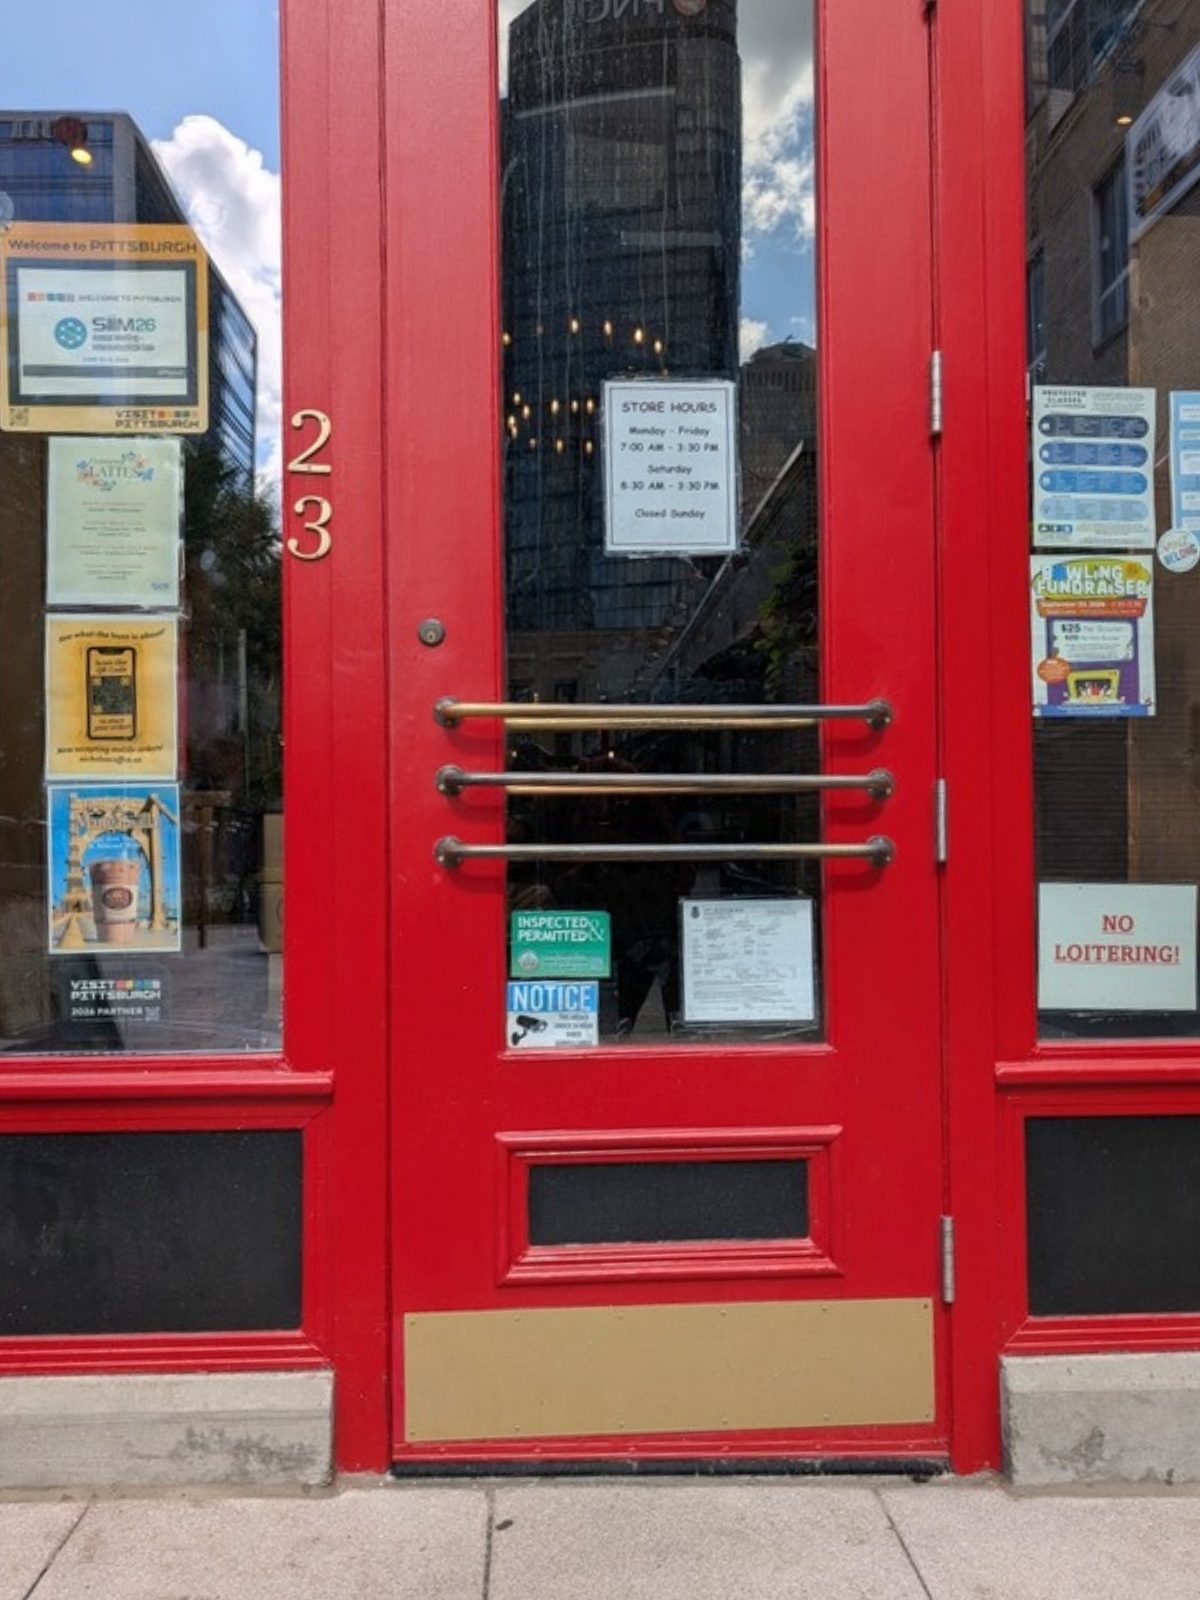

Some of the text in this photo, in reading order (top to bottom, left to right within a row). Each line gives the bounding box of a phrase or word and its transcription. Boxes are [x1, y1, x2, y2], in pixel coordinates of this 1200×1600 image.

[8, 240, 197, 254] Welcome to PITTSBURGH
[621, 402, 717, 413] STORE HOURS
[115, 410, 155, 419] VISIT
[114, 420, 199, 429] PITTSBURGH
[629, 427, 666, 436] Monday
[678, 426, 710, 437] Friday
[648, 443, 664, 452] AM
[704, 443, 719, 452] PM
[647, 465, 692, 475] Saturday
[648, 481, 664, 490] AM
[704, 481, 719, 490] PM
[634, 508, 705, 519] Closed Sunday
[1038, 579, 1149, 596] FUNDRAISER
[517, 916, 589, 928] INSPECTED
[1102, 914, 1134, 933] NO
[517, 929, 589, 942] PERMITTED
[1054, 944, 1180, 964] LOITERING!
[70, 980, 115, 989] VISIT
[70, 990, 161, 1000] PITTSBURGH
[512, 985, 592, 1012] NOTICE
